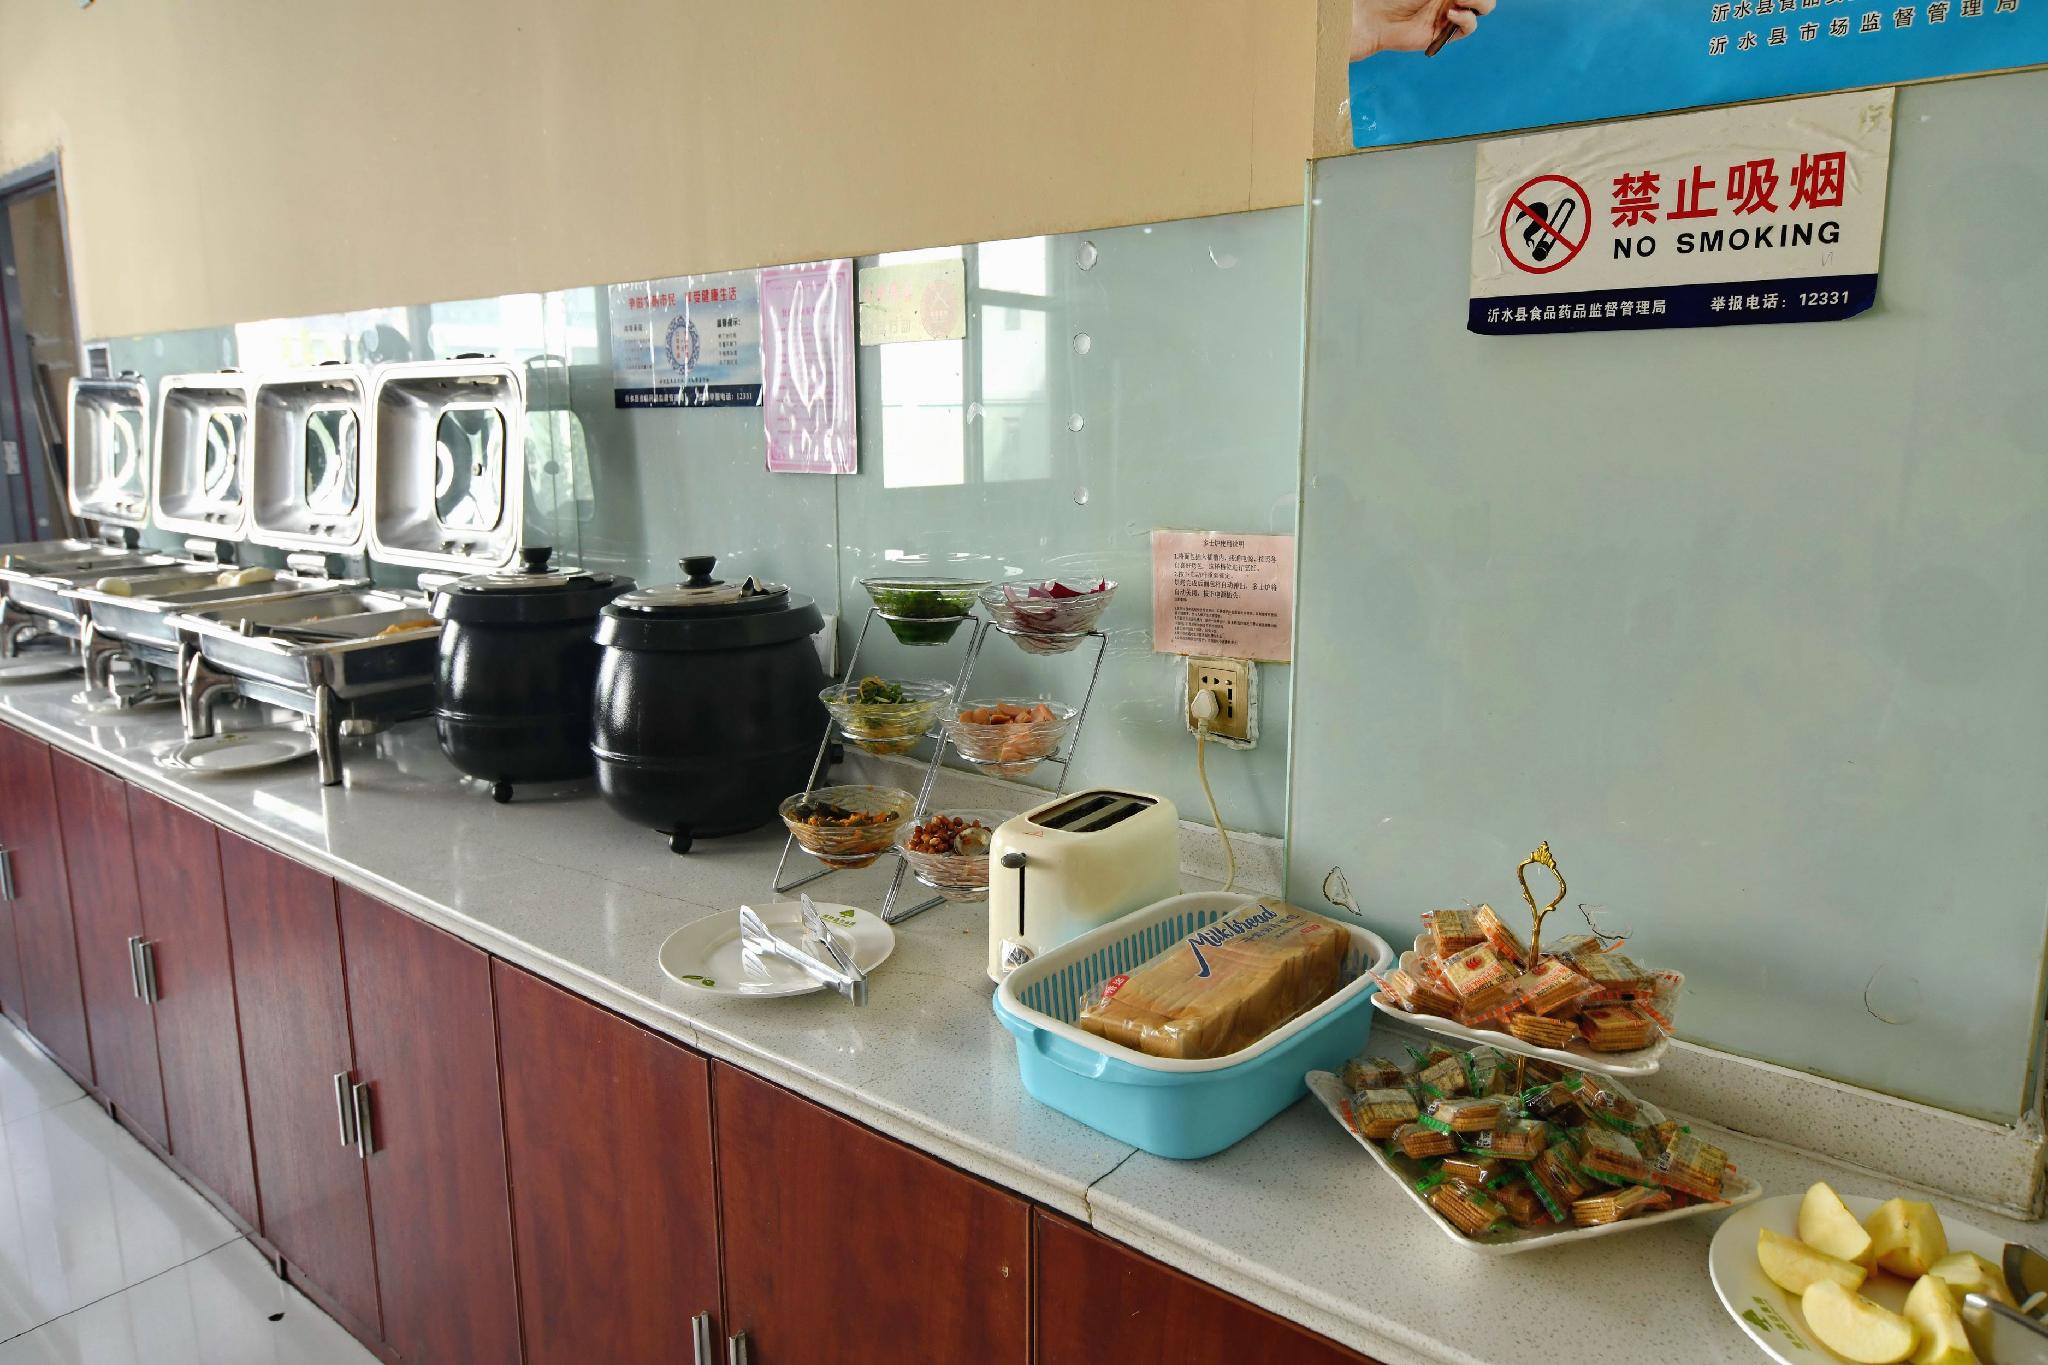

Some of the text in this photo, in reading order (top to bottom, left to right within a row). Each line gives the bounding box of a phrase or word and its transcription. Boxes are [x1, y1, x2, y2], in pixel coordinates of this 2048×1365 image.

[1708, 0, 2018, 55] 沂水县市场监督管理局
[1712, 0, 1843, 22] 沂水县食品
[1610, 151, 1847, 228] 禁止吸烟
[1613, 221, 1841, 259] NO SMOKING
[1487, 290, 1850, 323] 沂水县食品药品监督管理局 举报电话： 12331
[1188, 927, 1235, 977] Milk
[1223, 905, 1278, 935] bread
